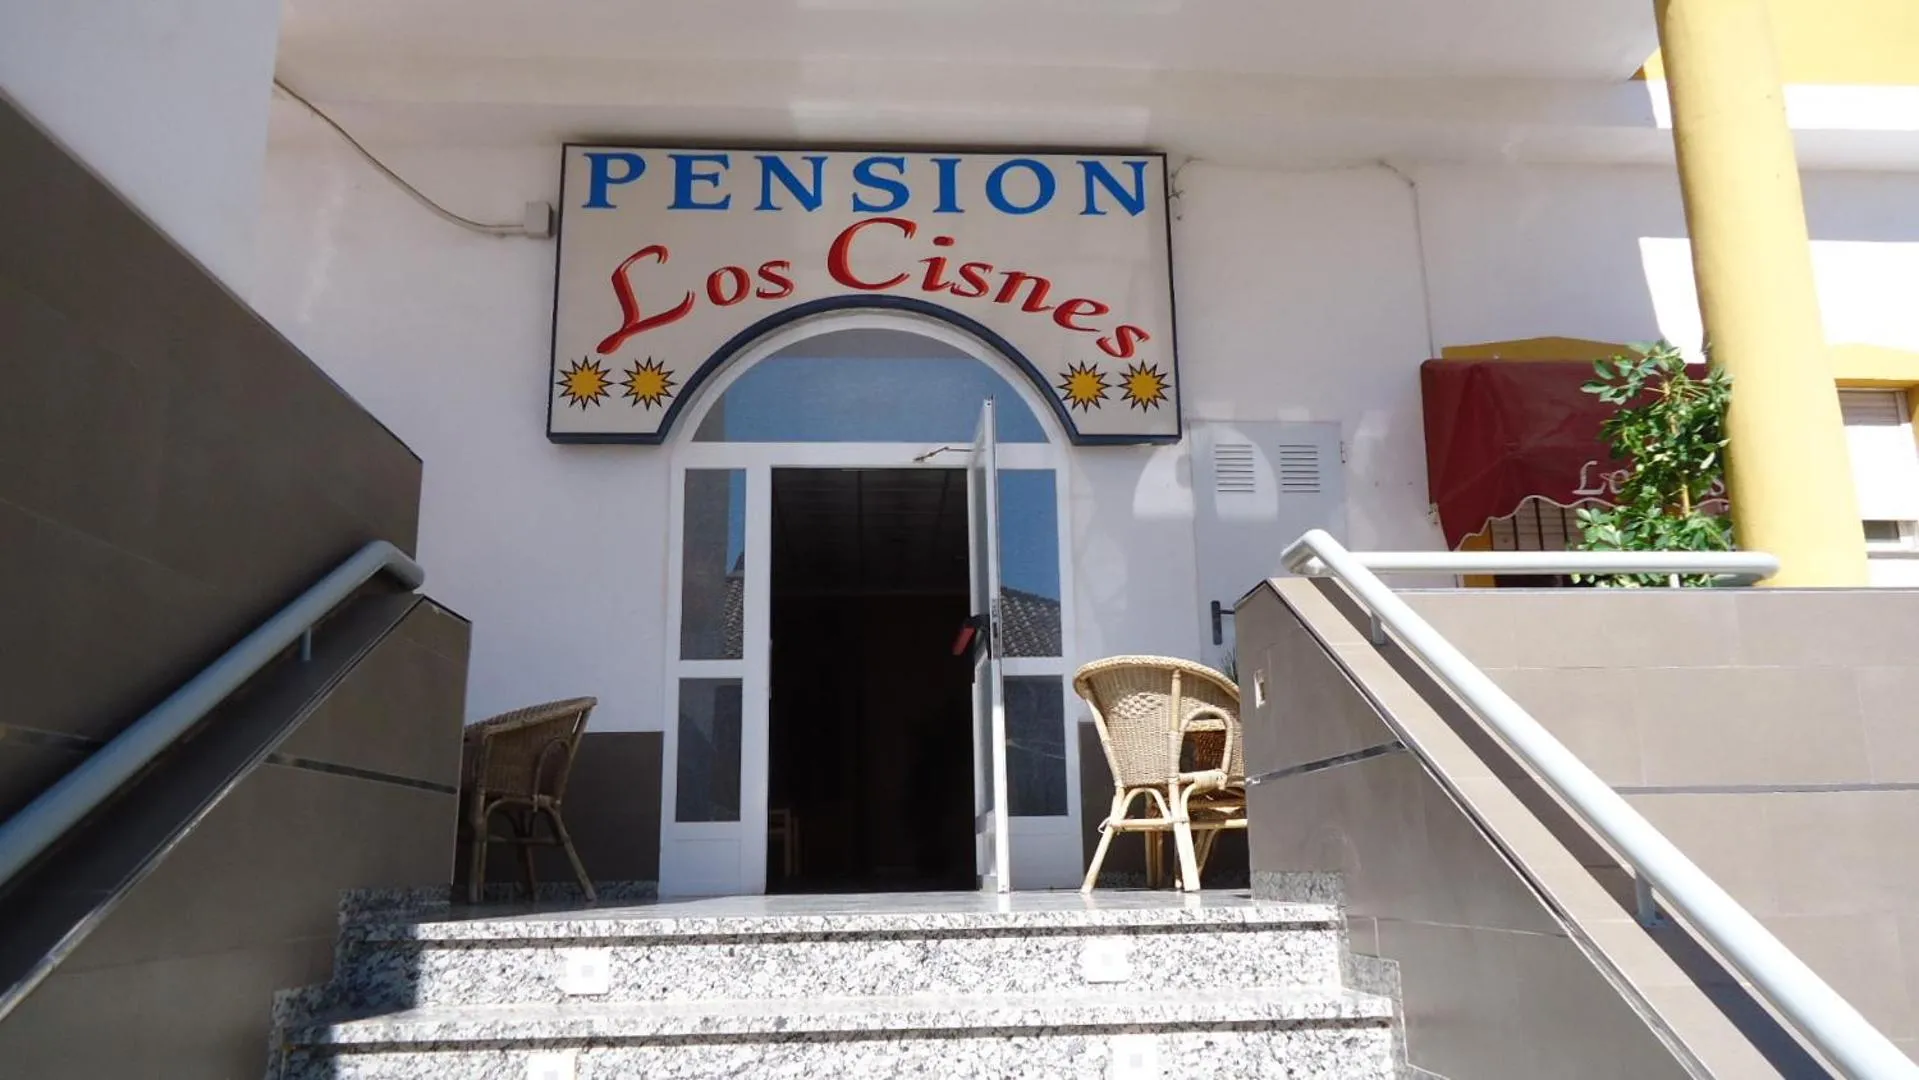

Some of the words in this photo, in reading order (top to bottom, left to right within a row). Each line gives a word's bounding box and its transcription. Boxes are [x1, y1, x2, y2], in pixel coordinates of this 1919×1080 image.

[581, 151, 1149, 216] PENSION
[596, 244, 795, 354] Los
[826, 217, 1151, 360] Cisnes
